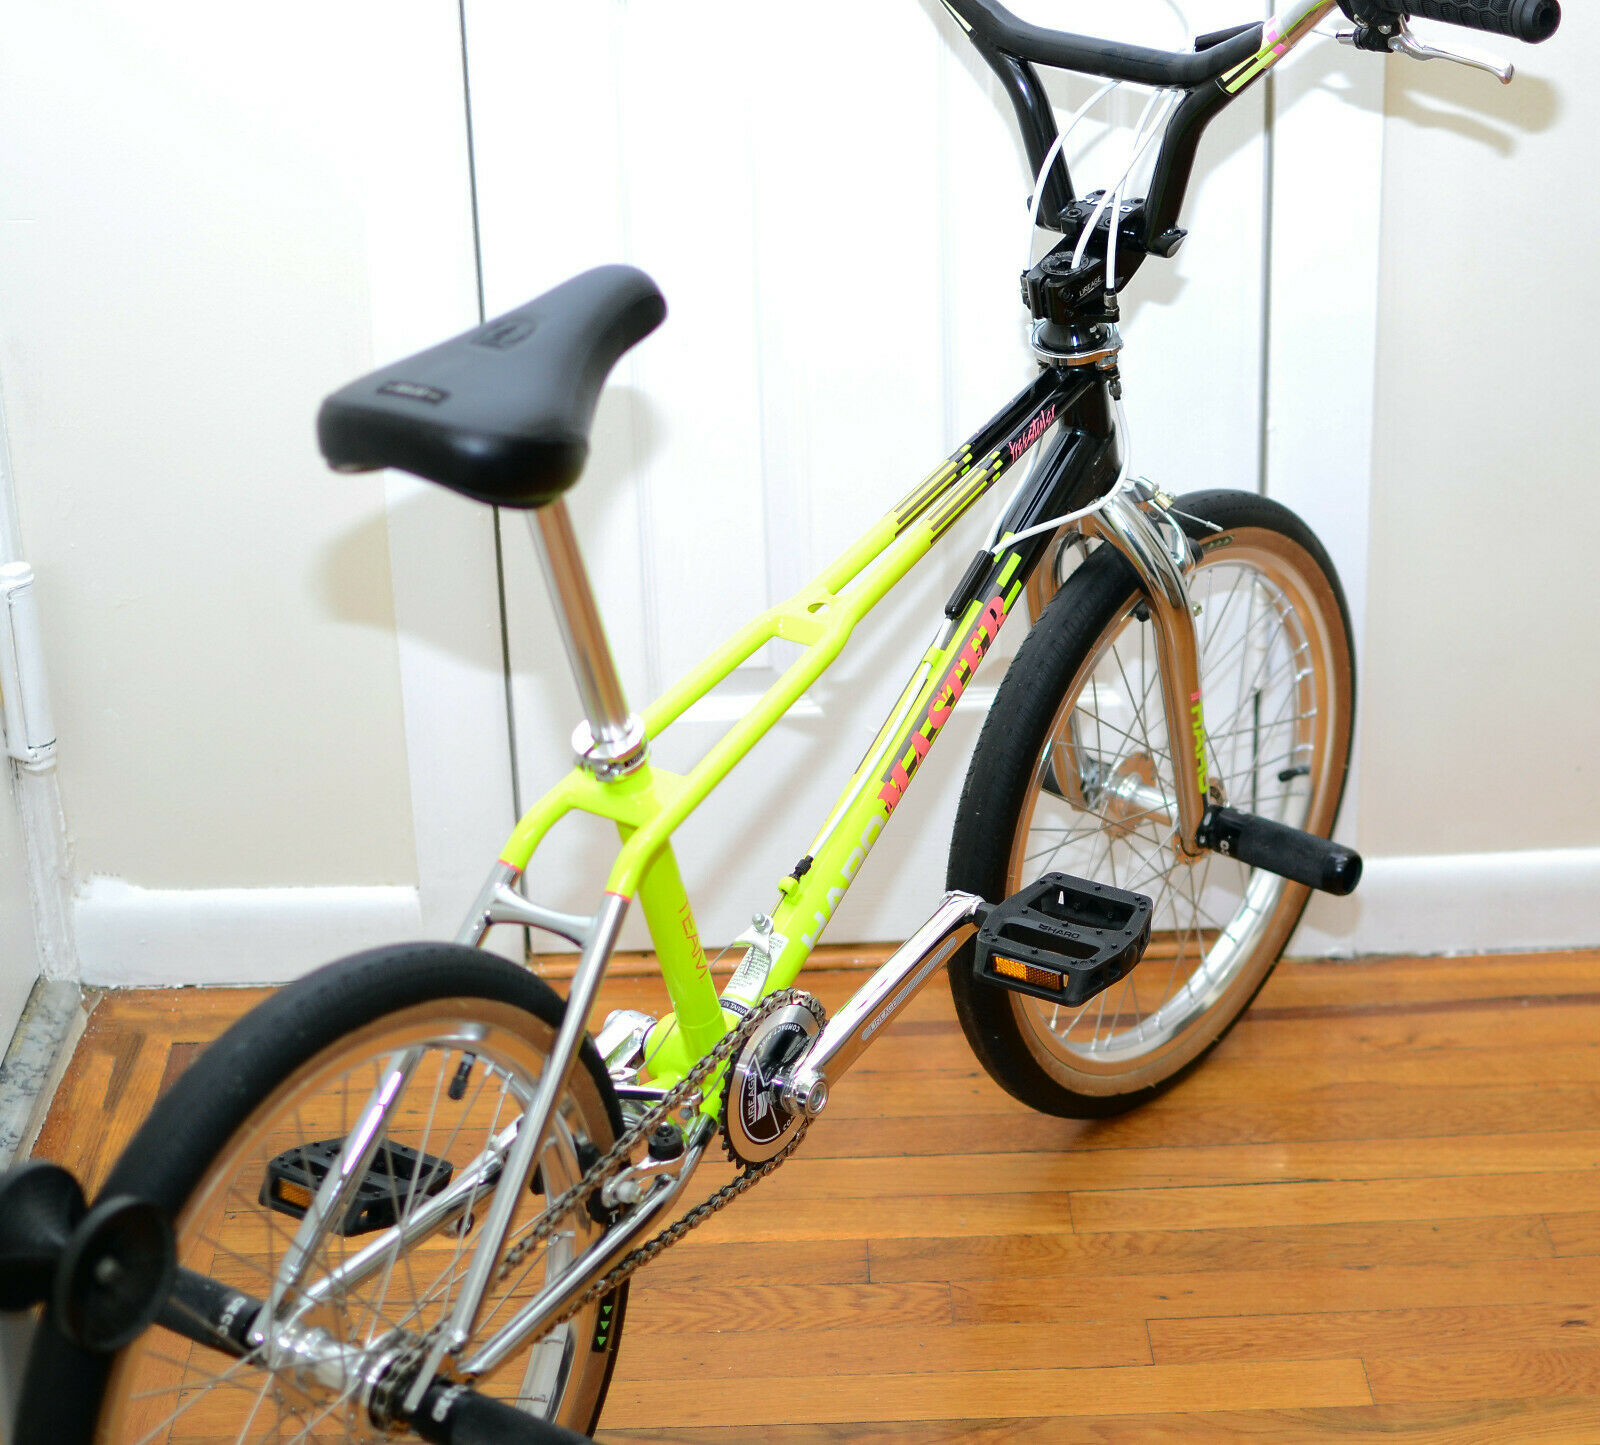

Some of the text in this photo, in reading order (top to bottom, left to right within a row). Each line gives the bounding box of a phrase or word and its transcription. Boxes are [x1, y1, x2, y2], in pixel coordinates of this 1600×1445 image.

[878, 595, 1008, 815] MASTER
[678, 892, 708, 980] TEAM
[801, 814, 885, 950] HARO
[1047, 927, 1080, 939] HARO
